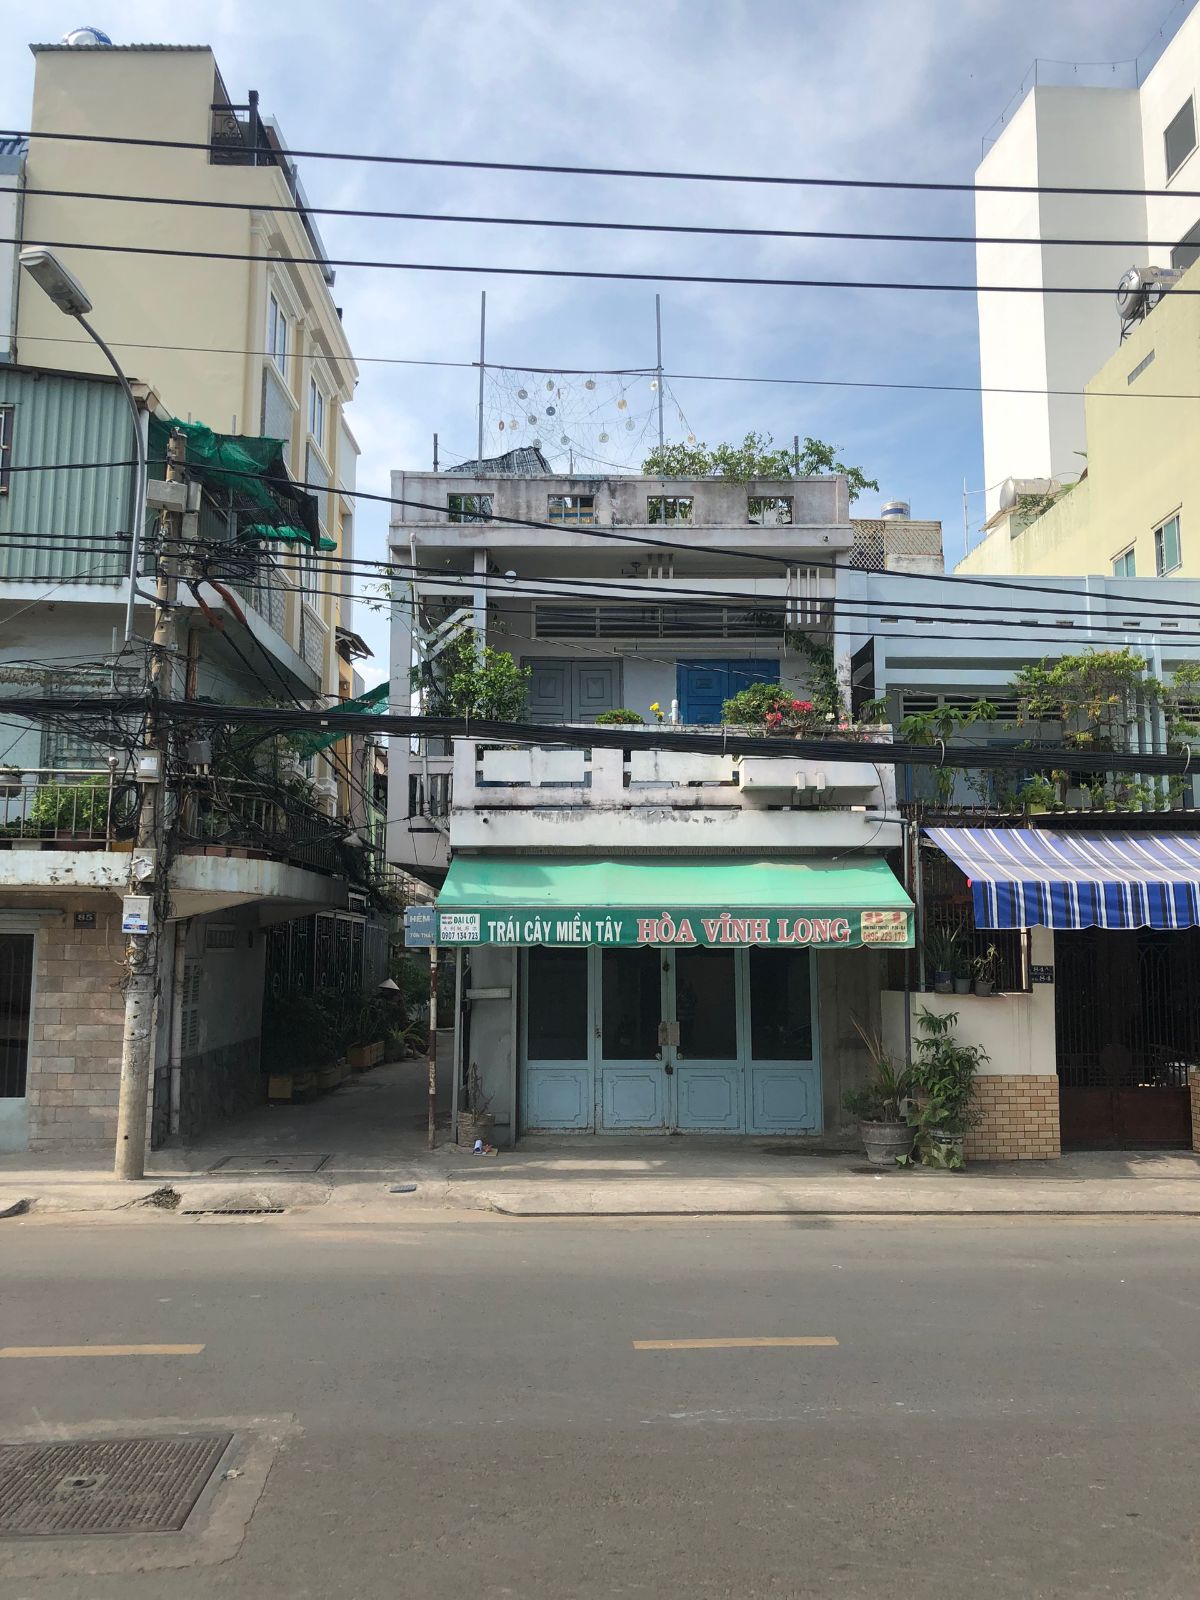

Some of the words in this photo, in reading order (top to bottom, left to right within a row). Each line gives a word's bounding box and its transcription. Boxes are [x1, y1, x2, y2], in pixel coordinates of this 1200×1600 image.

[457, 931, 467, 940] 134
[468, 931, 479, 940] 723
[487, 915, 520, 942] TRÁI
[524, 915, 552, 942] CÂY
[556, 912, 592, 942] MIỀN
[595, 915, 623, 942] TÂY
[637, 912, 697, 943] HÒA
[701, 912, 771, 943] VĨNH
[777, 918, 851, 943] LONG
